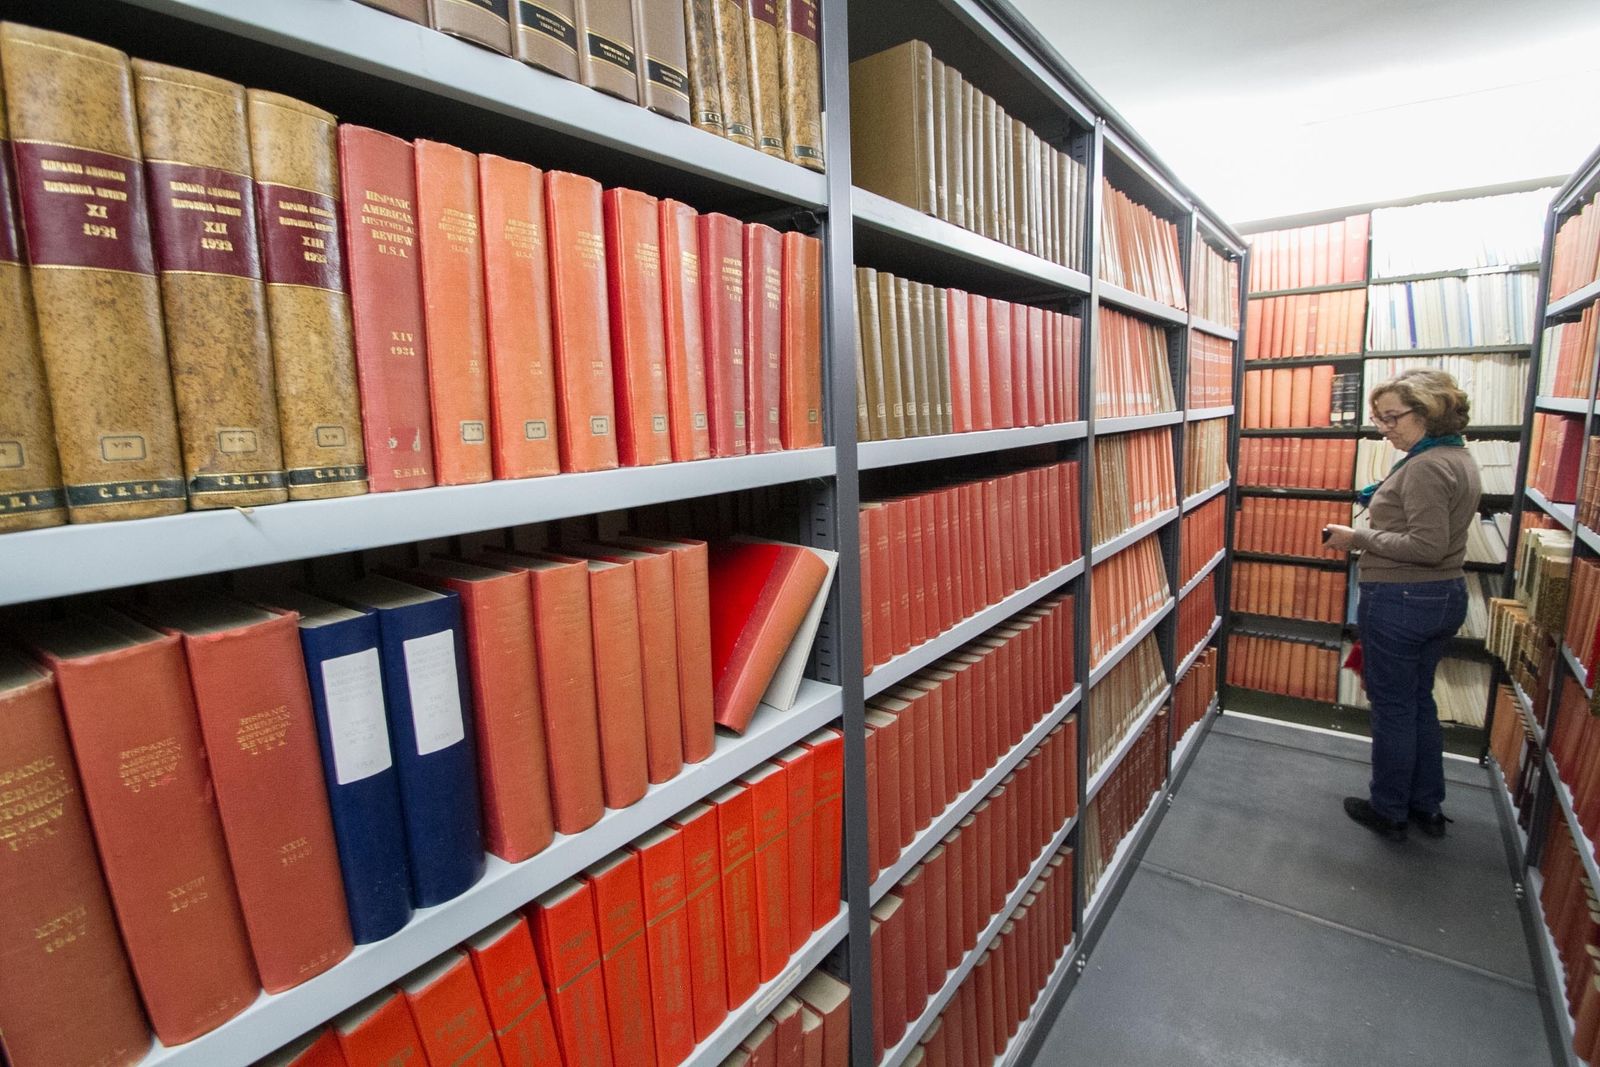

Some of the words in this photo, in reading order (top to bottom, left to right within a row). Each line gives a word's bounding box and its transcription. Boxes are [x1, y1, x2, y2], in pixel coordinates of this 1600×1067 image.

[366, 190, 411, 210] HISPANIC
[85, 203, 108, 219] XI
[362, 203, 414, 225] AMERICAN
[202, 221, 228, 235] XII
[372, 229, 413, 247] REVIEW
[391, 331, 414, 343] XIV
